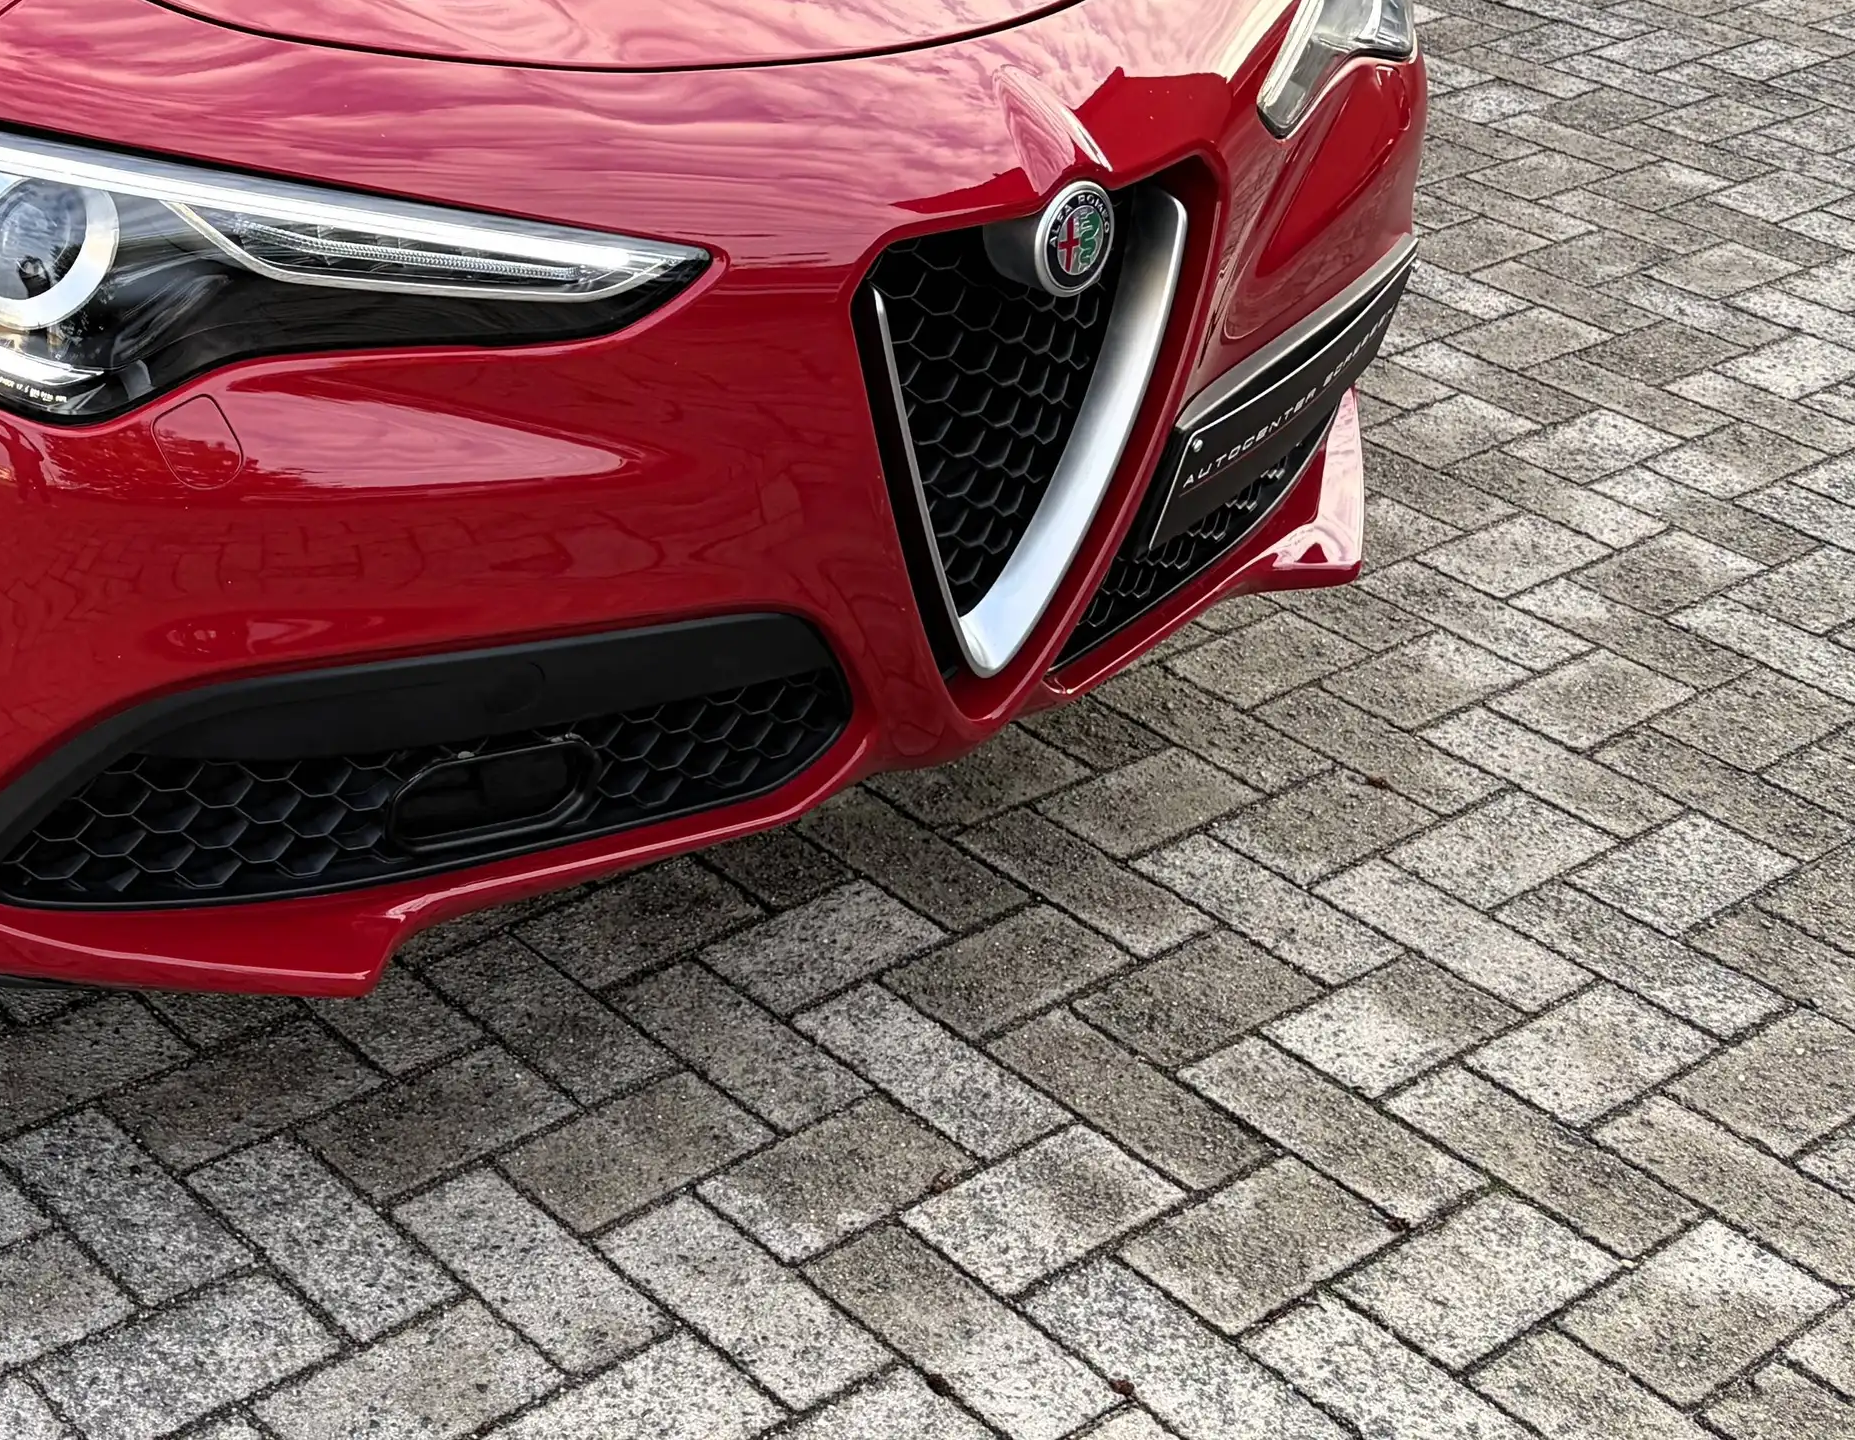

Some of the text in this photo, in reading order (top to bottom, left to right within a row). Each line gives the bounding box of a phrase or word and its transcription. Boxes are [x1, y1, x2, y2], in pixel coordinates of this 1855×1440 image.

[1049, 194, 1110, 248] ALFA ROMEO
[1182, 388, 1317, 489] AUTOCENTER
